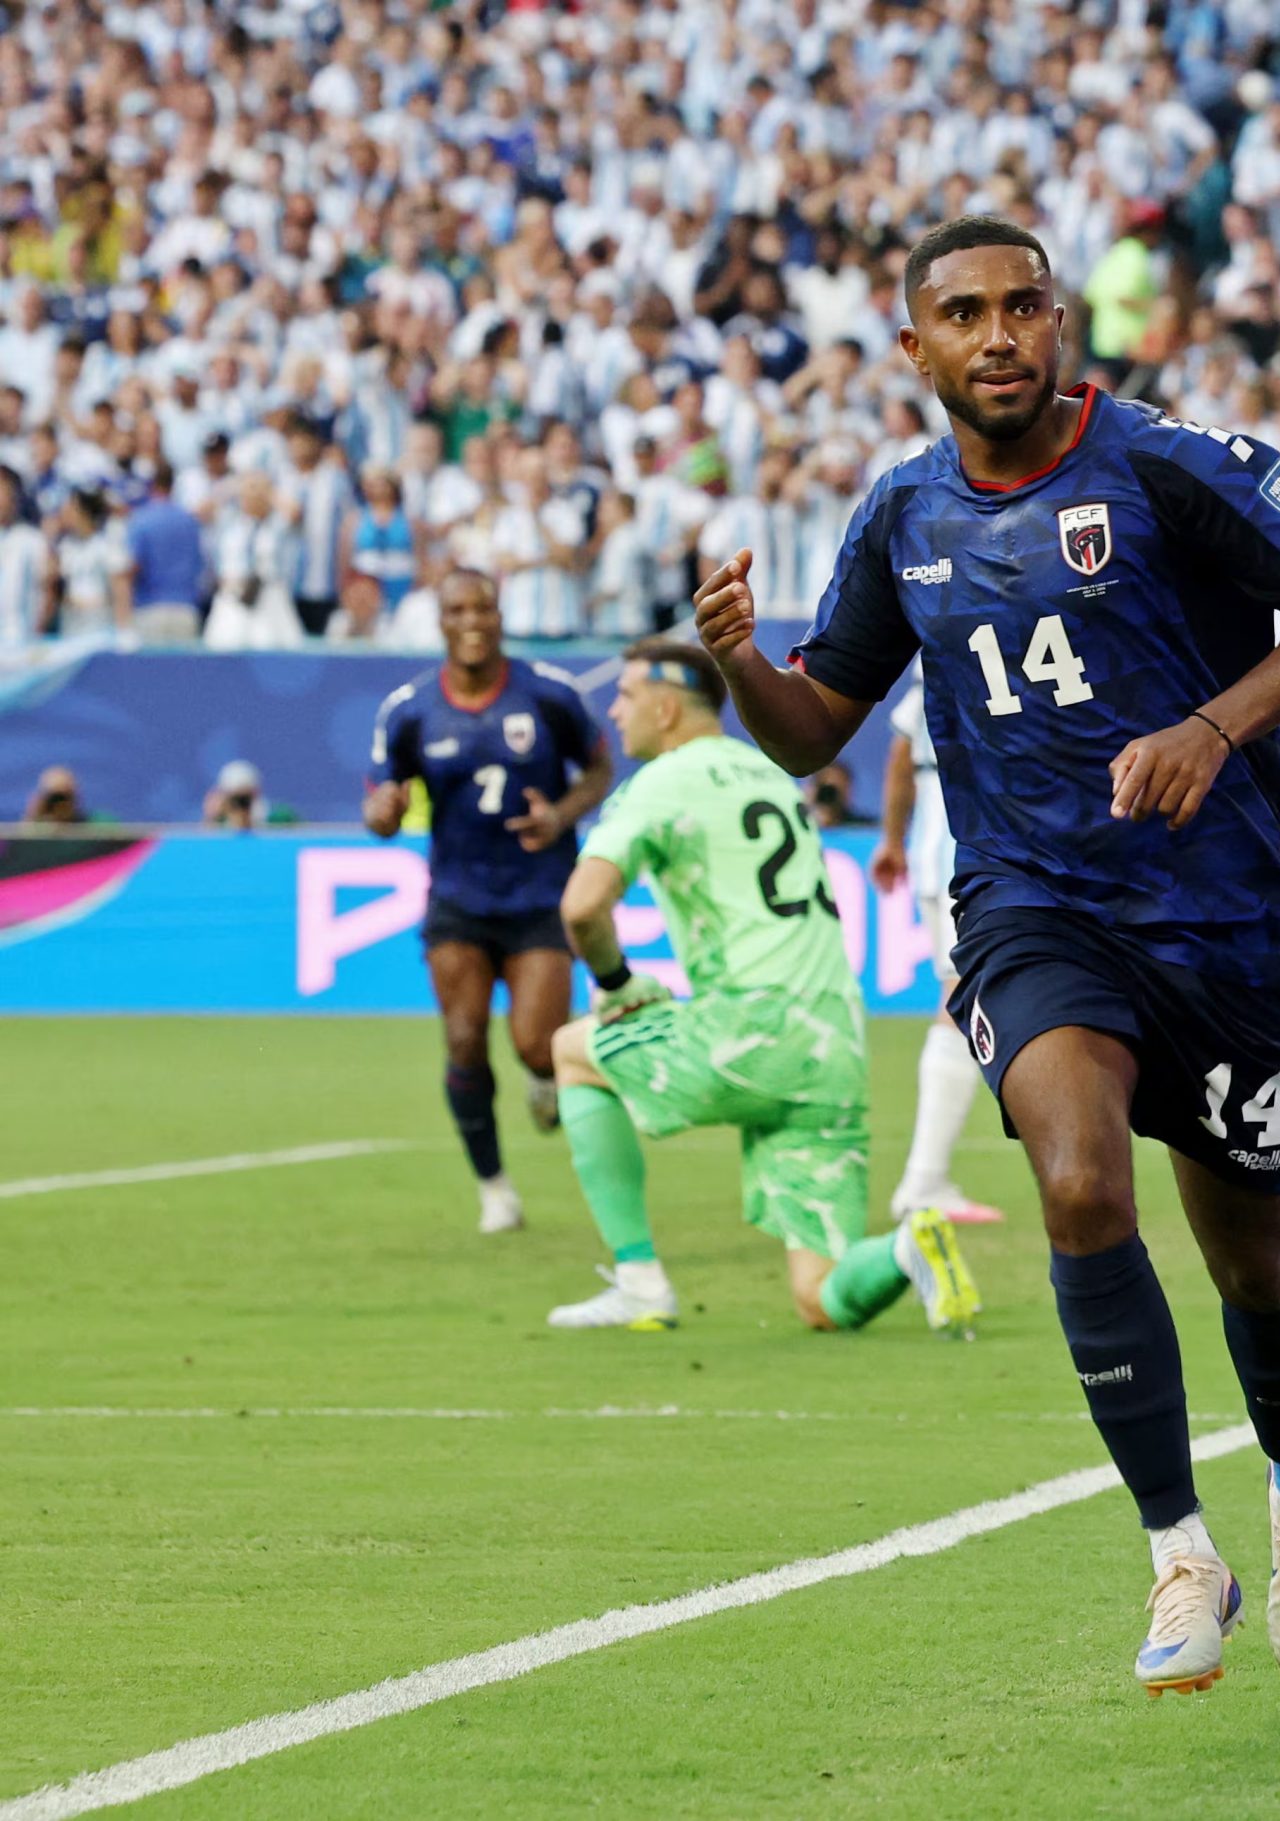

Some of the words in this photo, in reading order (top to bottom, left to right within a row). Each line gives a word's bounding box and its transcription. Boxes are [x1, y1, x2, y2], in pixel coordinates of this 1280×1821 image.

[1063, 508, 1104, 524] FCF
[902, 557, 953, 584] capelli
[967, 614, 1094, 716] 14
